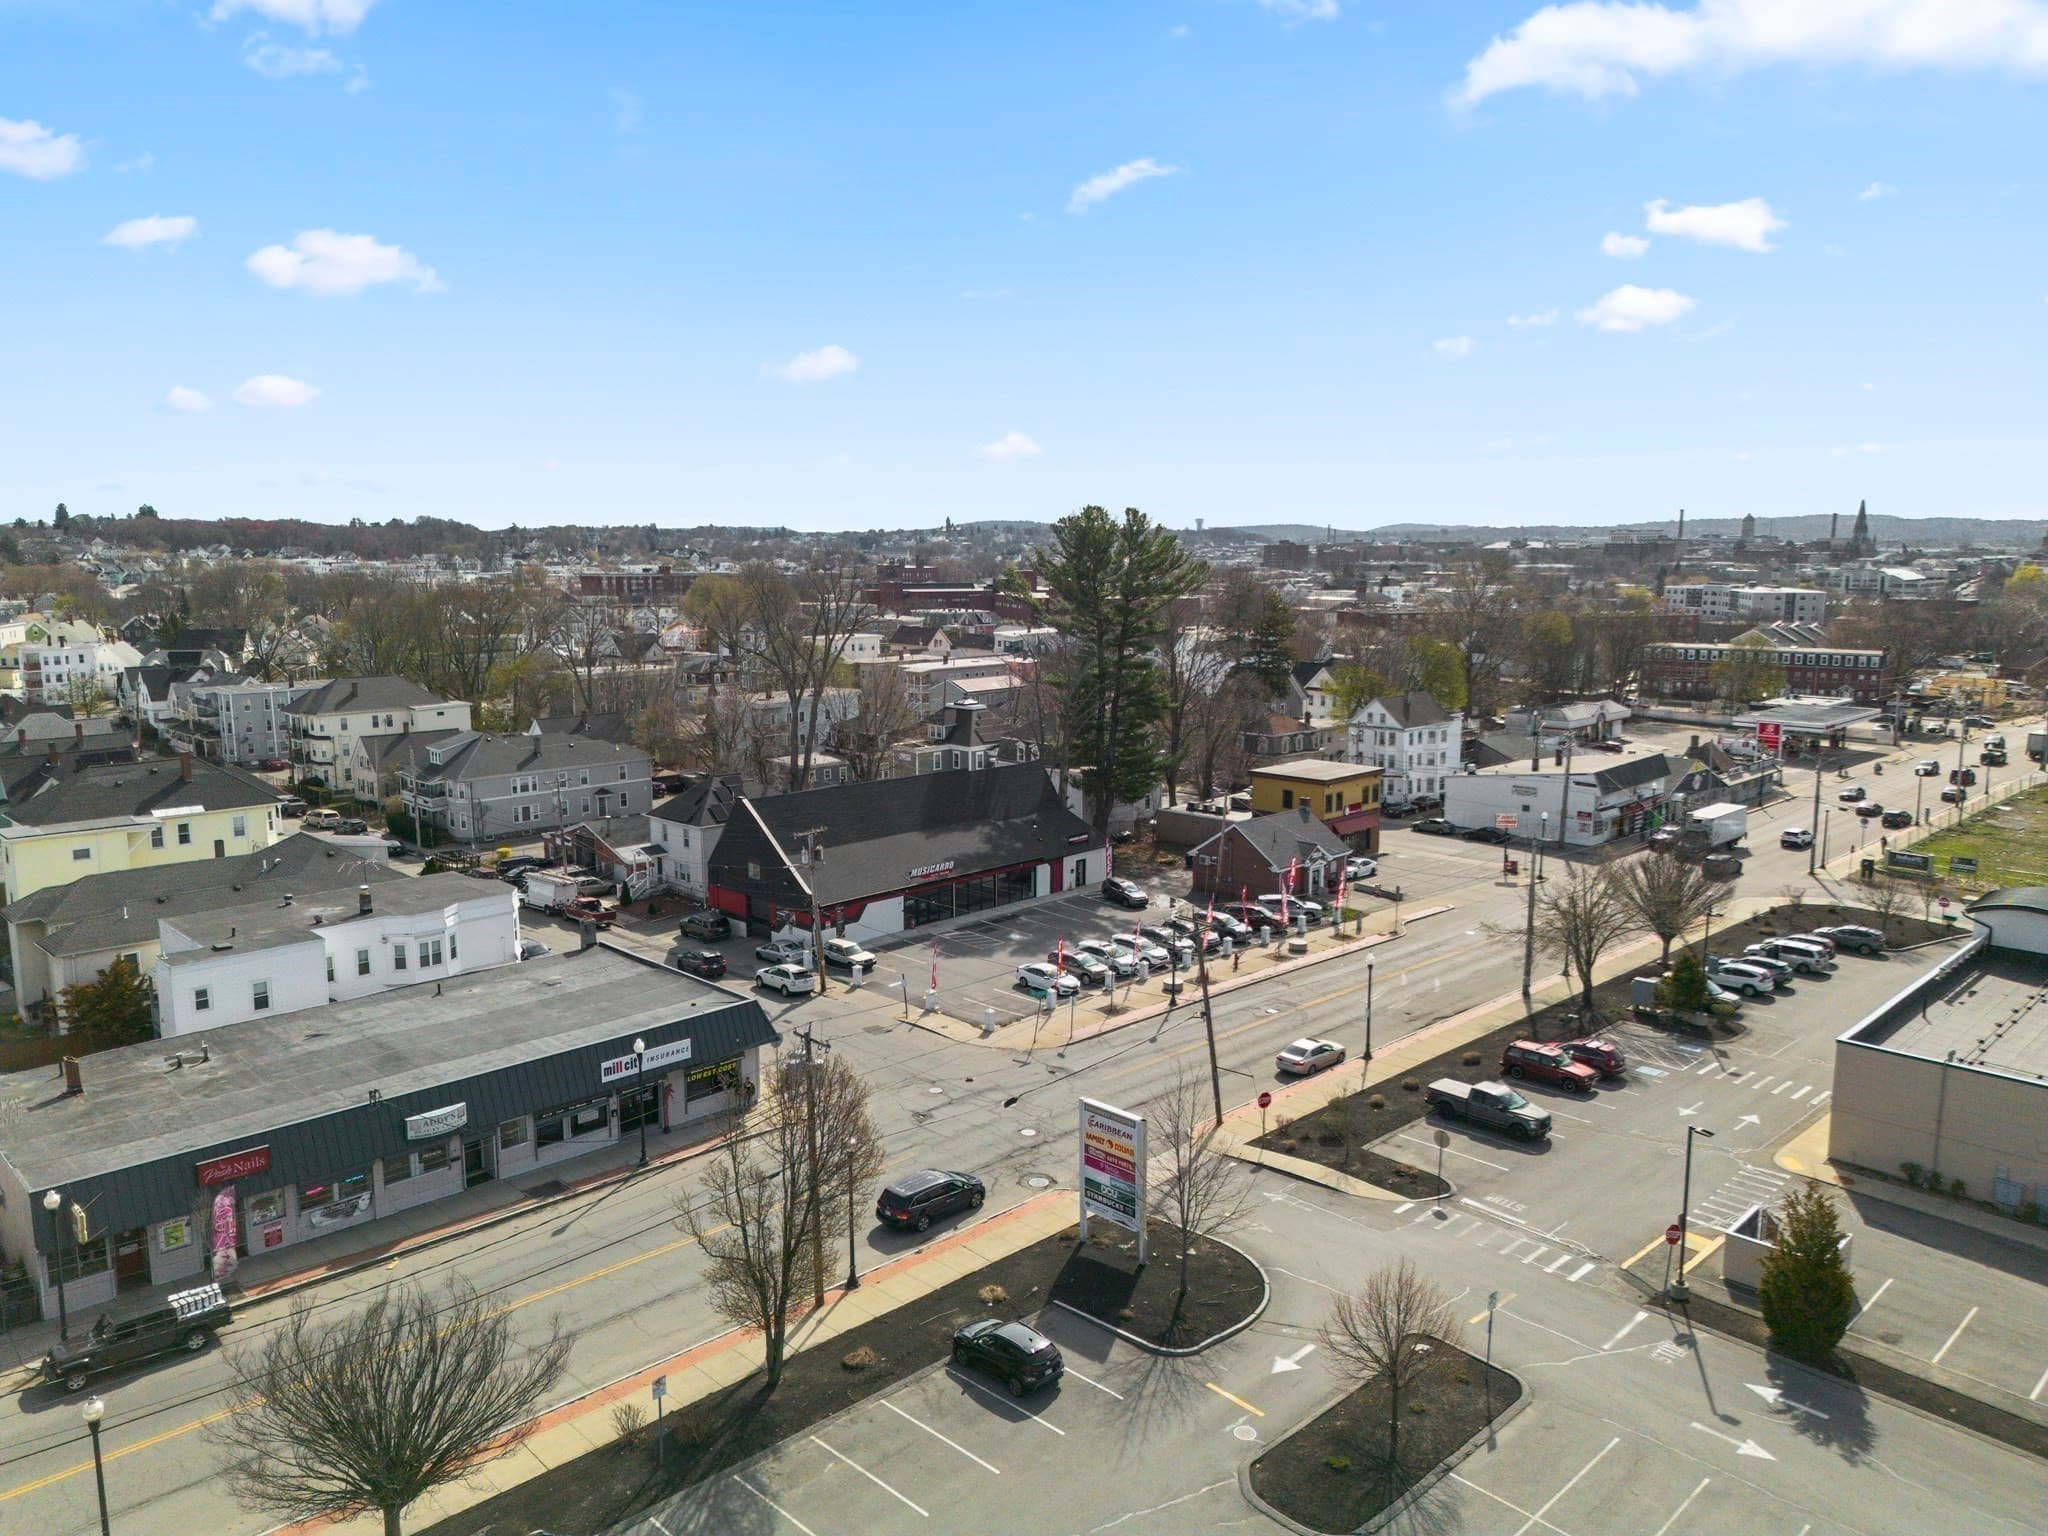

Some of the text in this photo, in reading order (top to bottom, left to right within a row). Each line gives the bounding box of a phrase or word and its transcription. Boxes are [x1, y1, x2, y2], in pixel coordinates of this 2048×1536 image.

[910, 861, 954, 877] MUSICARRO
[603, 1045, 690, 1077] mill cit INSURANCE
[688, 1062, 737, 1082] LOWEST COST
[1258, 1096, 1271, 1105] STOP
[1088, 1117, 1133, 1140] CARIBBEAN
[1085, 1132, 1105, 1145] FAMILY
[233, 1157, 265, 1173] Nails
[1087, 1191, 1125, 1211] STARBUCKS
